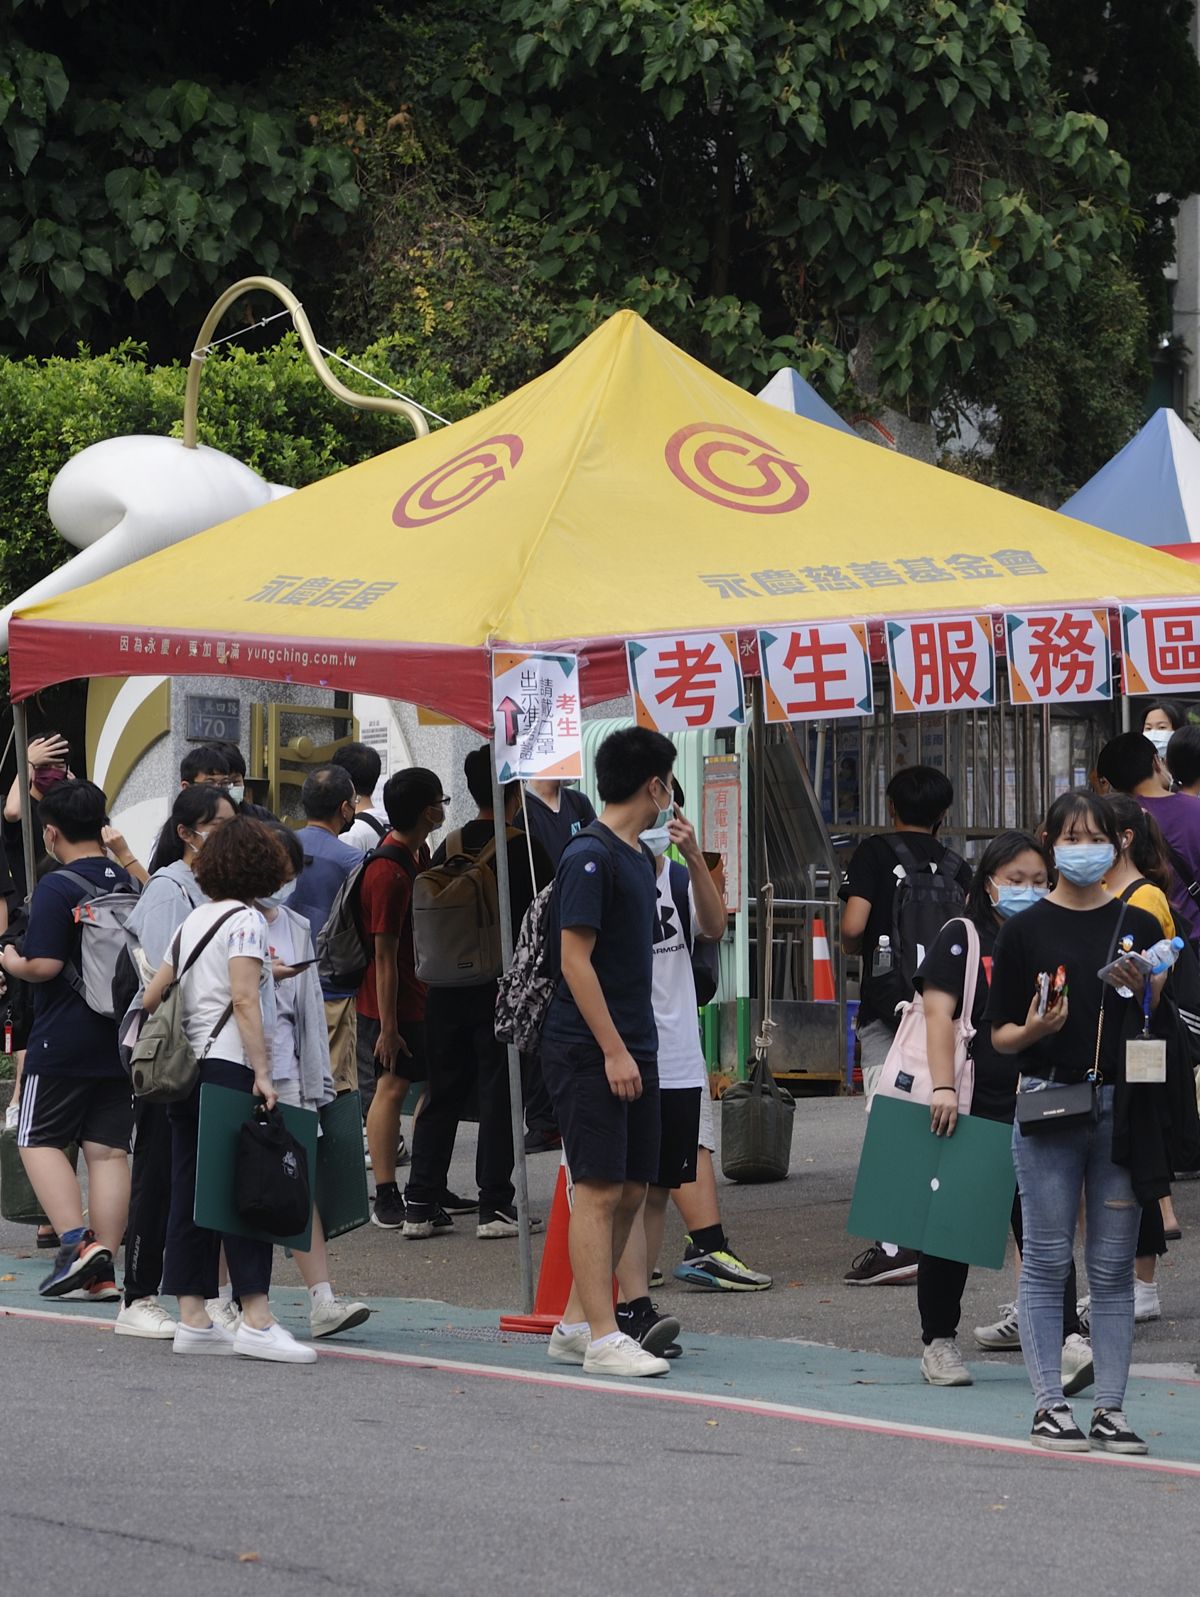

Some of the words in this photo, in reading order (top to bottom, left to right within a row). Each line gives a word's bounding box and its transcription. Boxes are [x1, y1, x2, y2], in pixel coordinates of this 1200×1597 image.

[244, 575, 399, 610] 永慶房屋
[697, 549, 1048, 599] 永慶慈善基金會
[247, 649, 357, 667] yungching.com.tw
[556, 693, 579, 737] 考生
